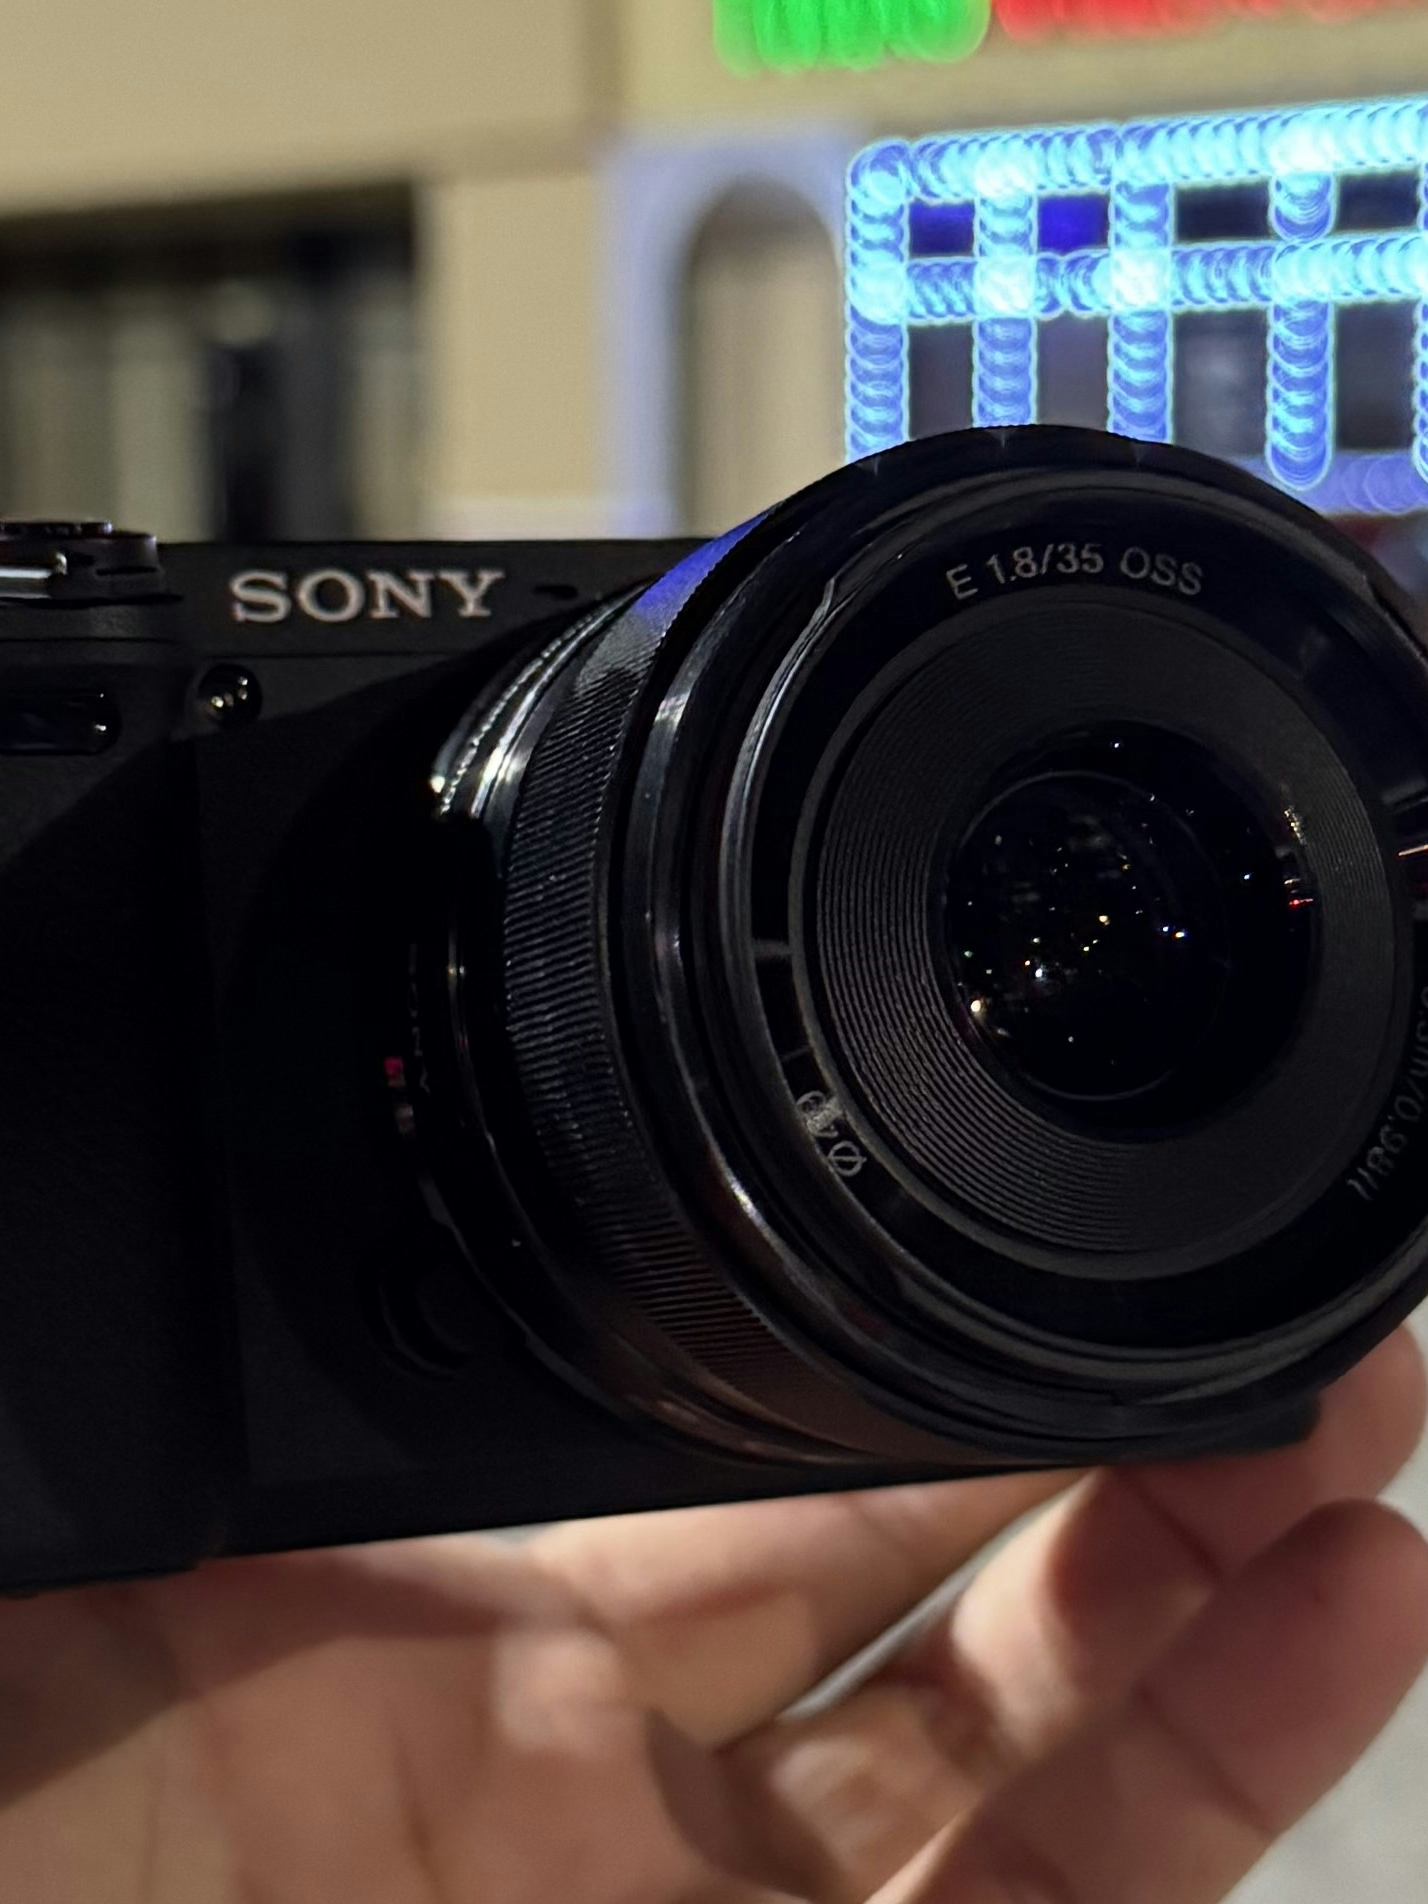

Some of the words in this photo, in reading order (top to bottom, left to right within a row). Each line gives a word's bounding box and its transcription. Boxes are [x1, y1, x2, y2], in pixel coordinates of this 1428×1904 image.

[228, 568, 506, 623] SONY
[946, 562, 979, 600] E
[985, 542, 1105, 585] 1.8/35
[1119, 546, 1204, 596] OSS
